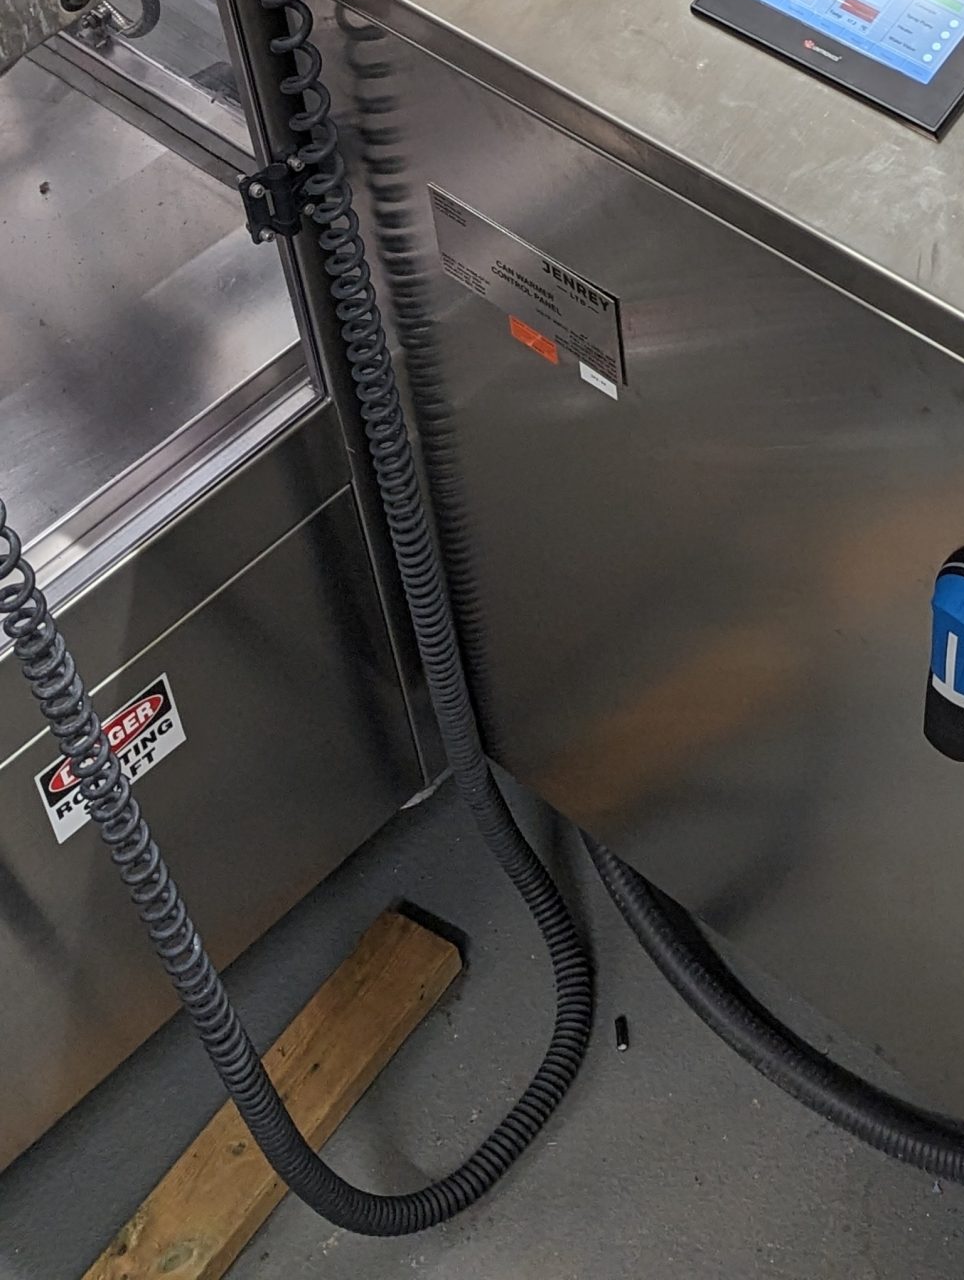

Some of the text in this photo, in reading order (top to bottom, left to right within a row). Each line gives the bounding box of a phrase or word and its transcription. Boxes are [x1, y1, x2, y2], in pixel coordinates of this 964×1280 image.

[491, 266, 531, 297] CONTROL
[533, 293, 562, 317] PANEL
[496, 260, 515, 277] CAN
[515, 272, 554, 302] WARMER
[542, 260, 610, 312] JENREY
